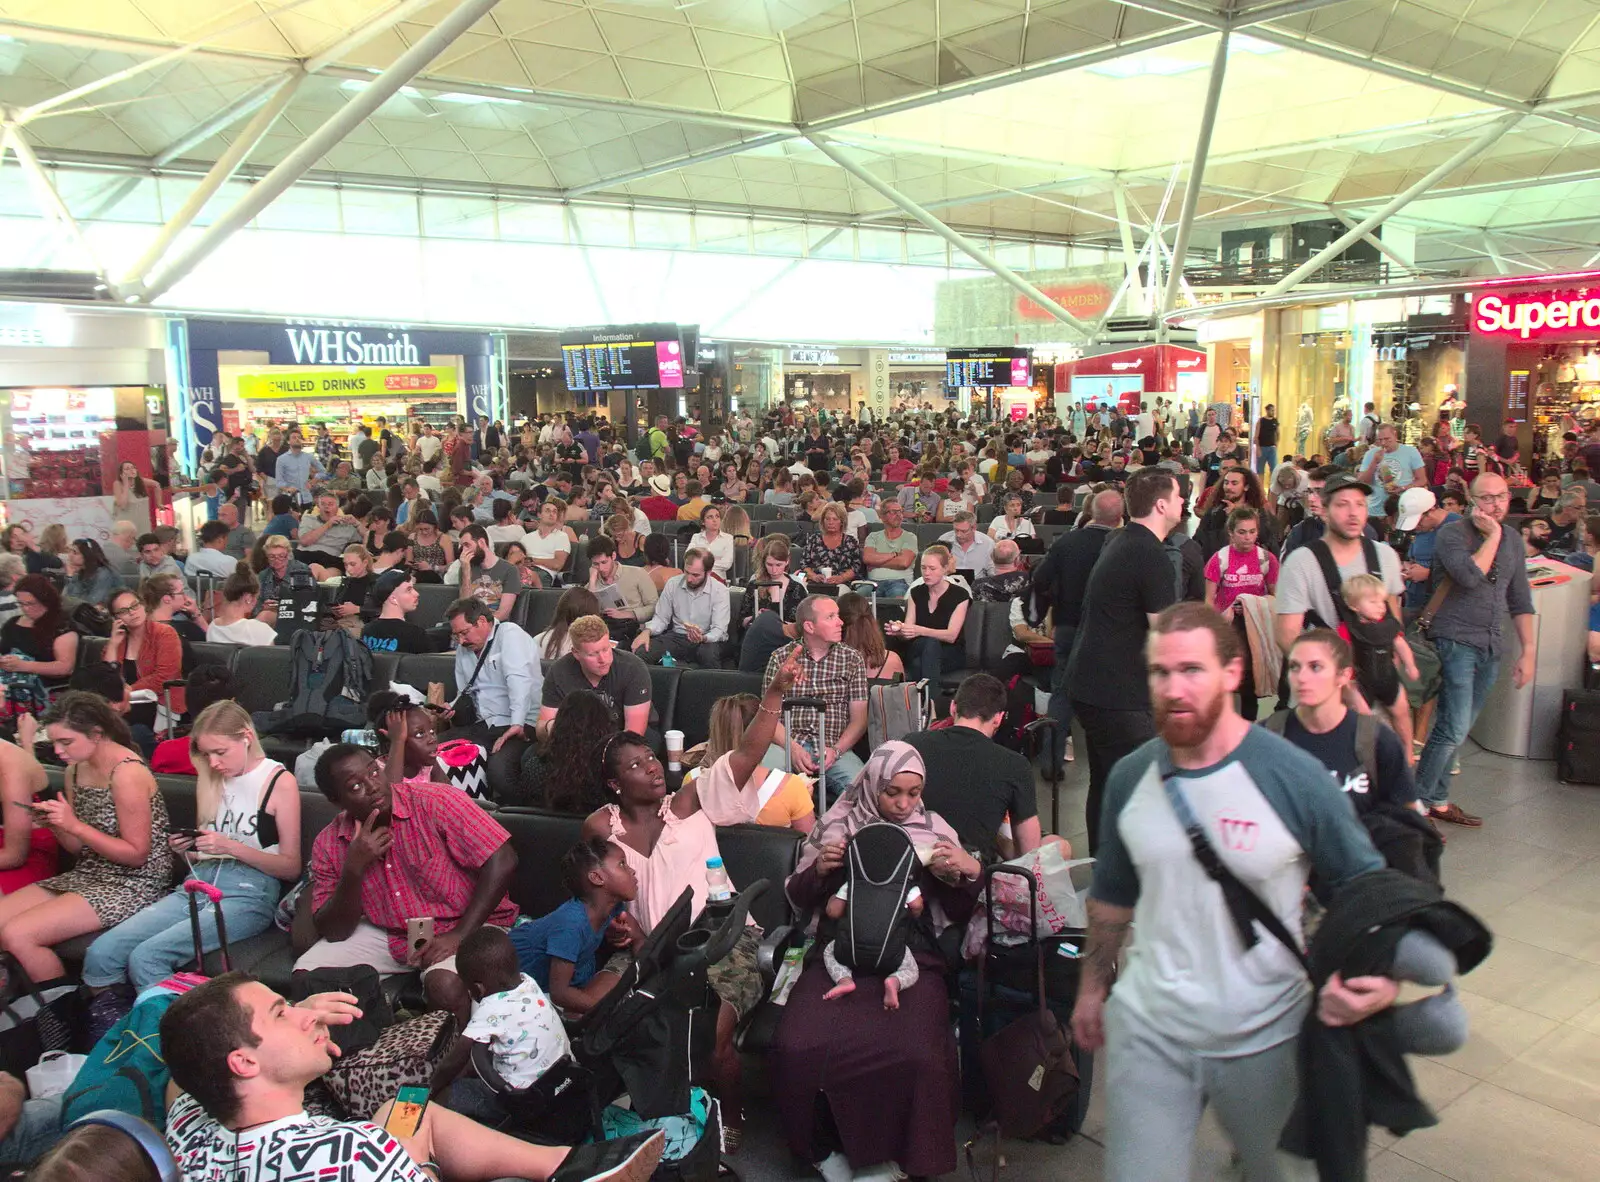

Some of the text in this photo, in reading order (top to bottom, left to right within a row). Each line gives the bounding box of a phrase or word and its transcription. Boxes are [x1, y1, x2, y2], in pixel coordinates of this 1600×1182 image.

[1053, 293, 1103, 307] CAMDEN
[593, 333, 634, 342] Information
[285, 328, 420, 365] WHSmith
[269, 378, 366, 392] CHILLED DRINKS
[188, 386, 214, 400] WH
